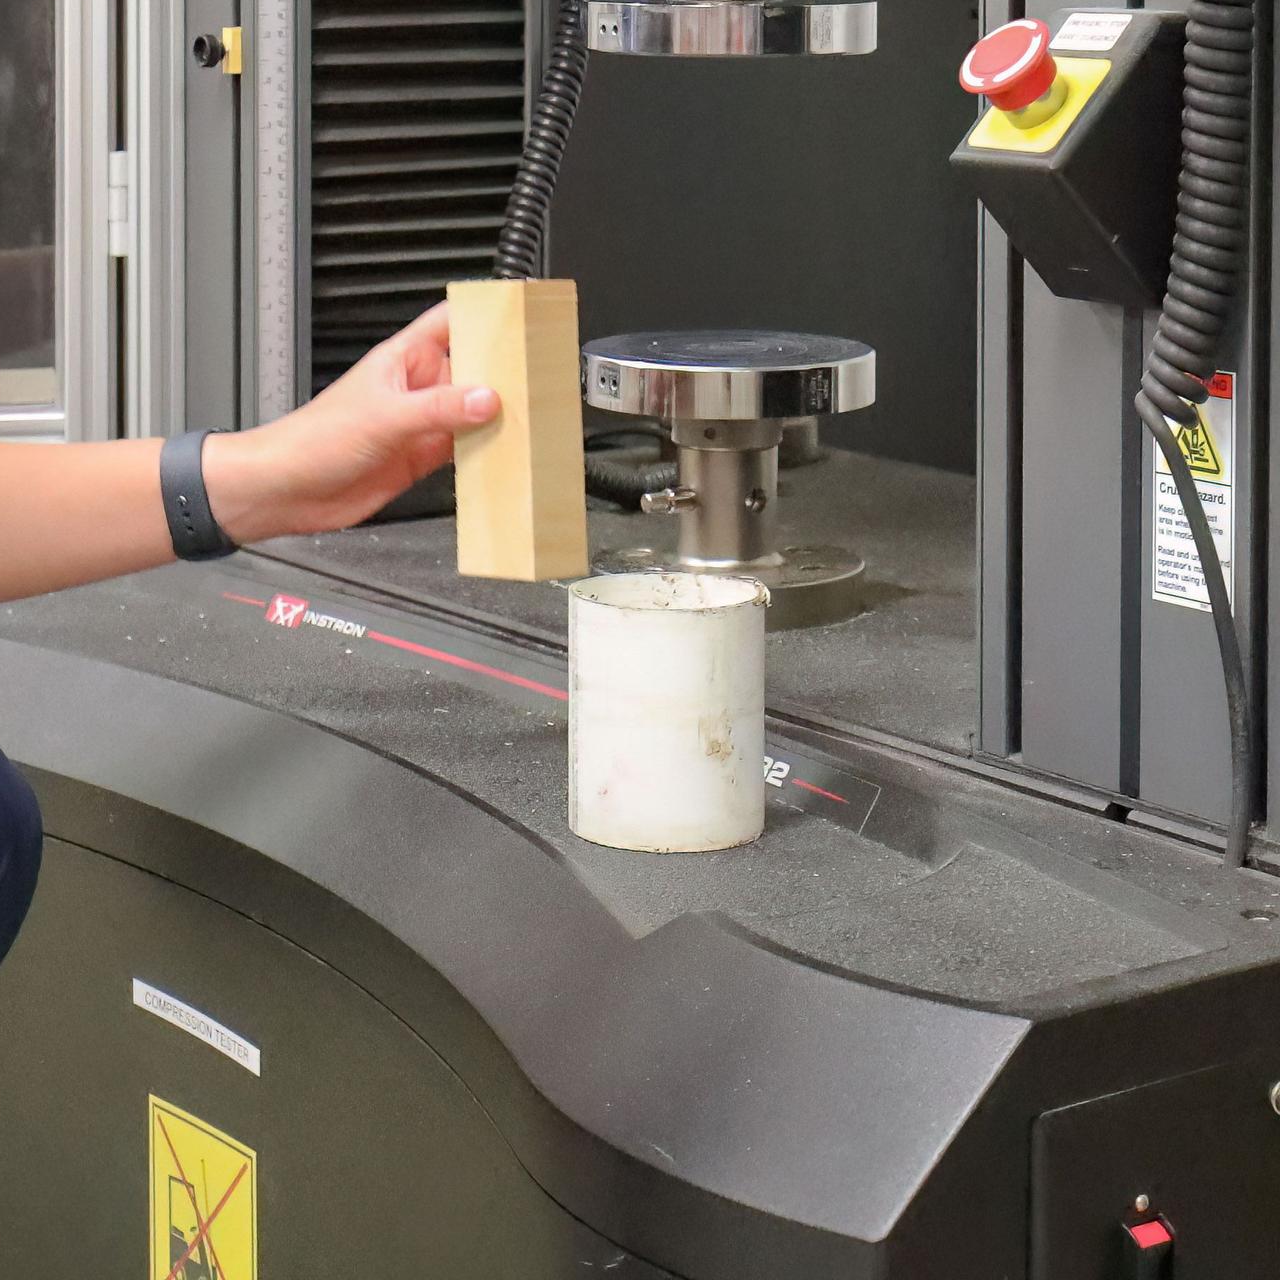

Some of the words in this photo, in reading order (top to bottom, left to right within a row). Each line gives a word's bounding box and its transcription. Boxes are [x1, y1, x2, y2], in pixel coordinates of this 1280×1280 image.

[302, 609, 367, 638] INSTRON
[145, 991, 213, 1040] COMPRESSION
[215, 1029, 249, 1062] TESTER
